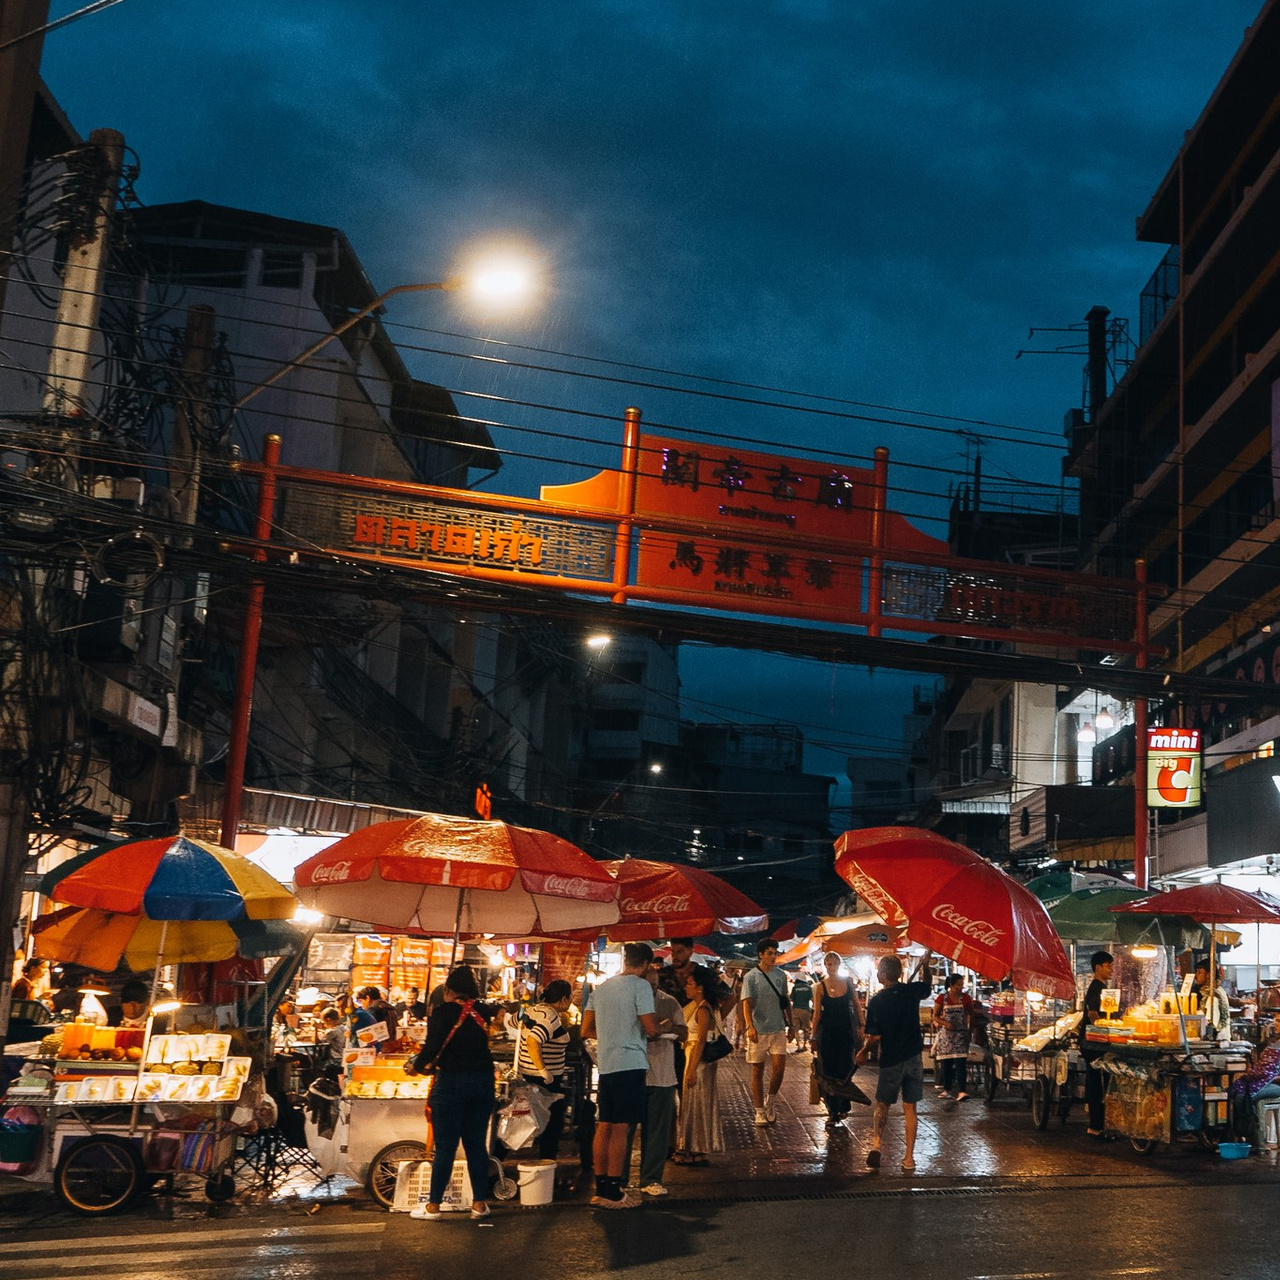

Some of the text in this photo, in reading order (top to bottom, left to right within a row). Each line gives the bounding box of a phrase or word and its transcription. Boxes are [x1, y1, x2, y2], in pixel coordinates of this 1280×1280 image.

[354, 515, 543, 564] ตลาดเก่า
[1150, 730, 1199, 749] mini
[1155, 756, 1178, 771] Big
[544, 874, 591, 896] Coca-Cola
[621, 894, 691, 915] Coca-Cola
[931, 903, 1006, 947] Coca-Cola
